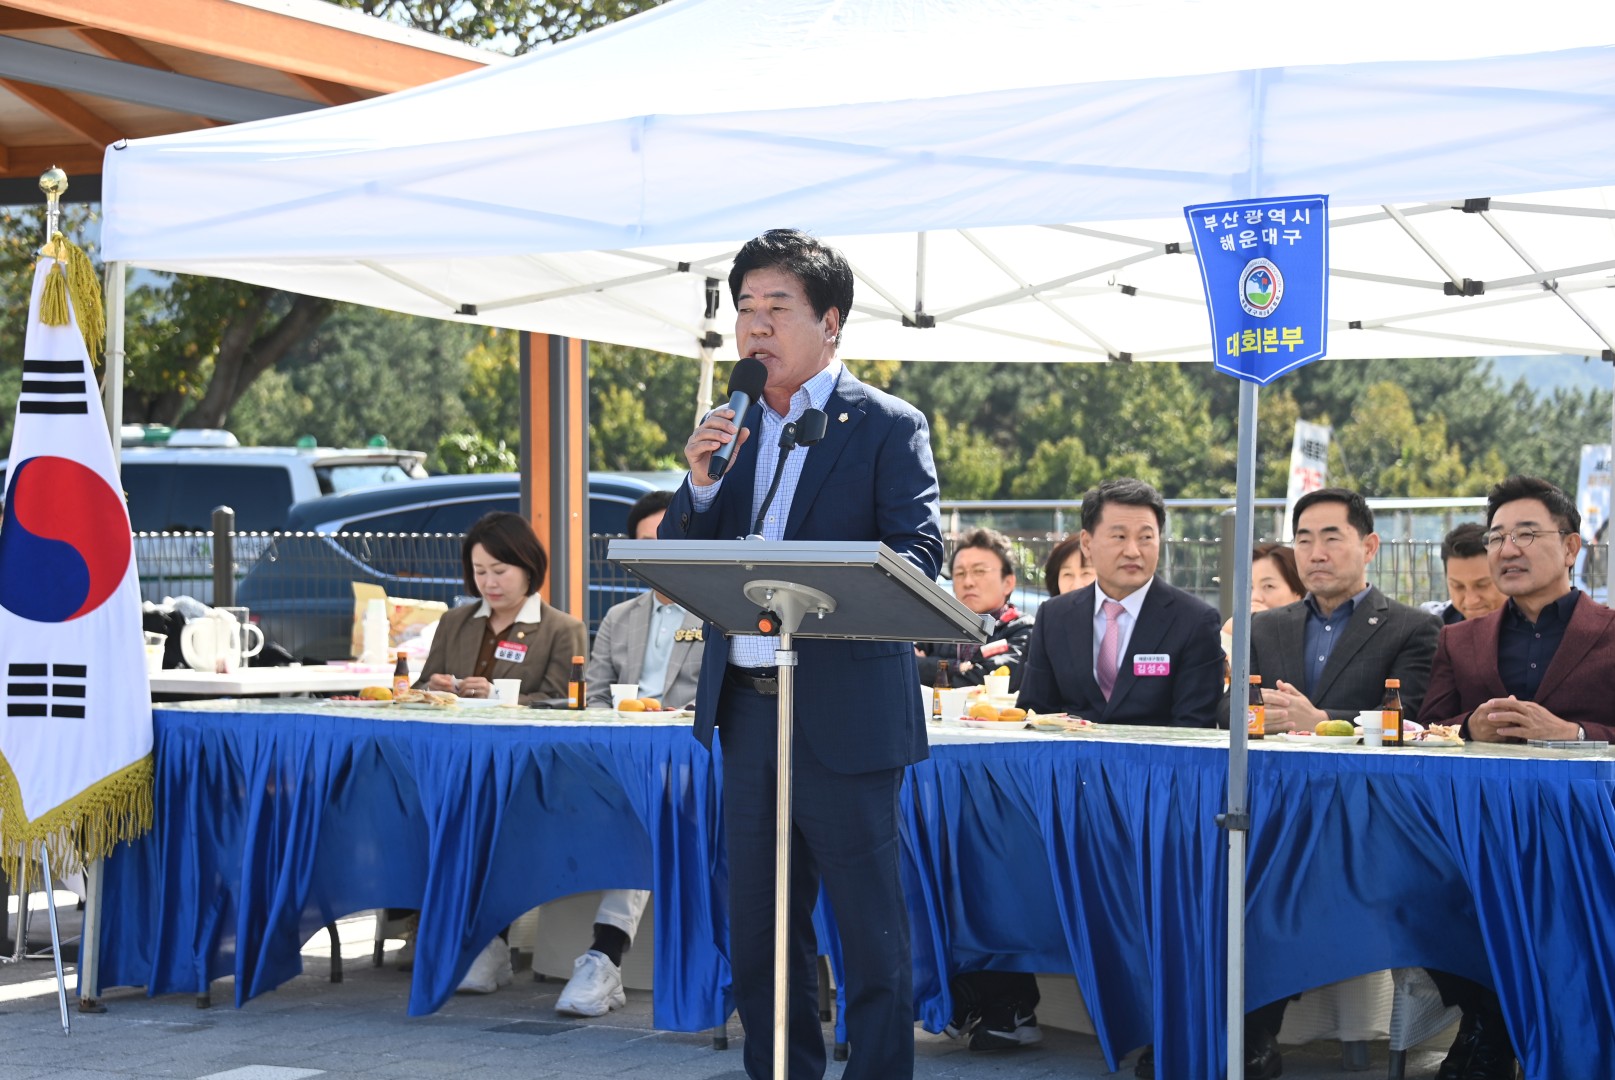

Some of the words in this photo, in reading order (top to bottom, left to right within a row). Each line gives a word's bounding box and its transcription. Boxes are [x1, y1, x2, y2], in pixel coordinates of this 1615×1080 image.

[1203, 208, 1310, 232] 부산광역시
[1219, 228, 1302, 251] 해운대구
[1226, 326, 1304, 357] 대회본부
[1137, 664, 1166, 674] 김성수
